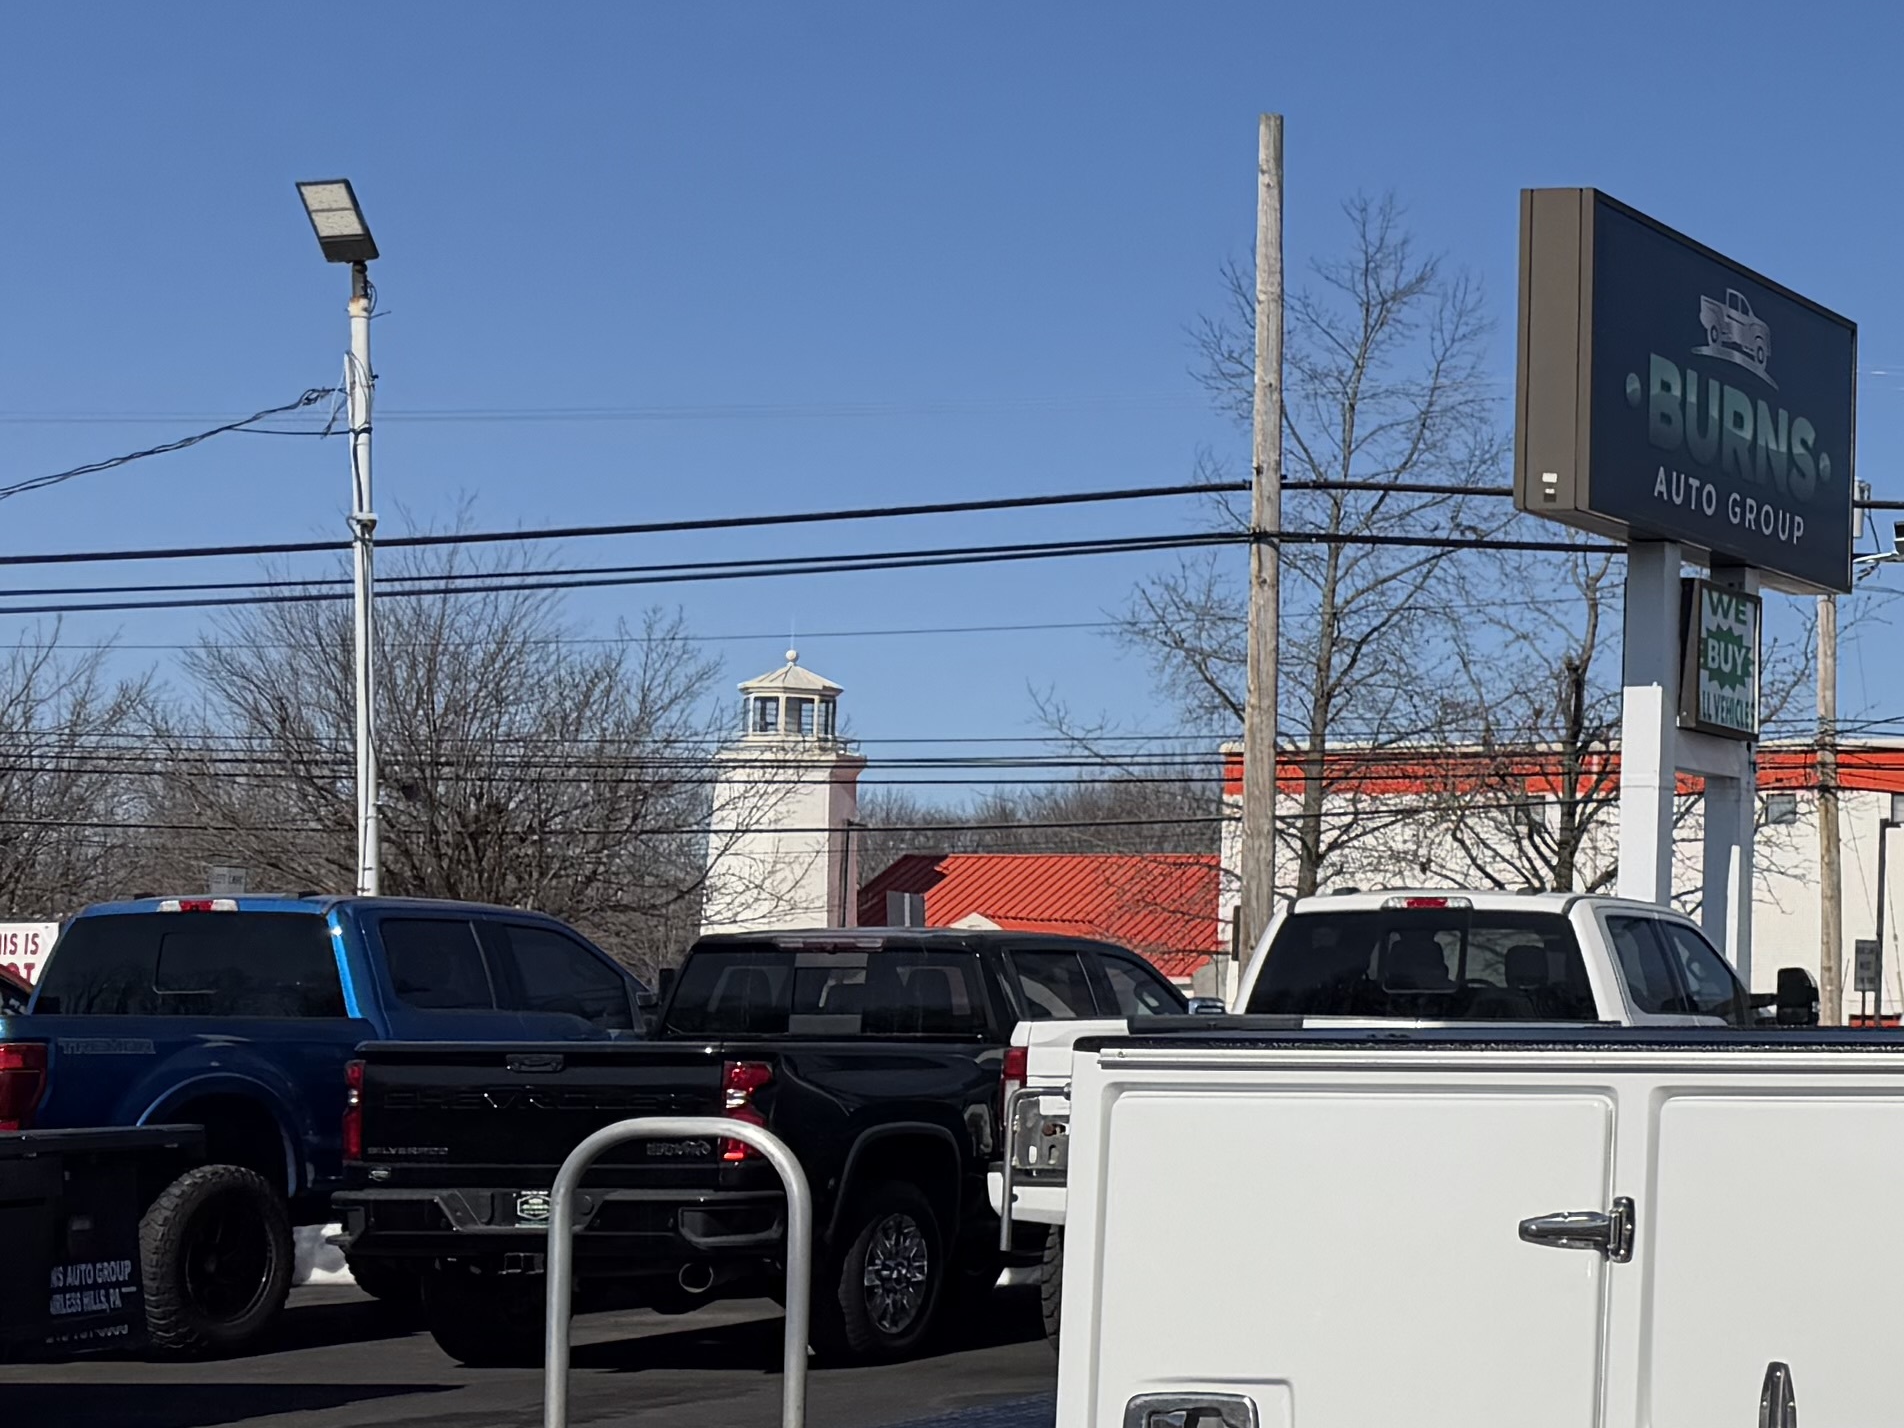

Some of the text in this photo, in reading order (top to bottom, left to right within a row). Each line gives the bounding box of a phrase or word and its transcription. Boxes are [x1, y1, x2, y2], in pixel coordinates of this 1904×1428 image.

[1648, 352, 1817, 504] BURNS
[1654, 465, 1806, 547] AUTO GROUP
[1708, 590, 1748, 625] WE
[1707, 637, 1747, 676] BUY
[1702, 690, 1712, 721] LL
[24, 932, 40, 956] IS
[66, 1263, 94, 1286] AUTO
[96, 1259, 132, 1284] GROUP
